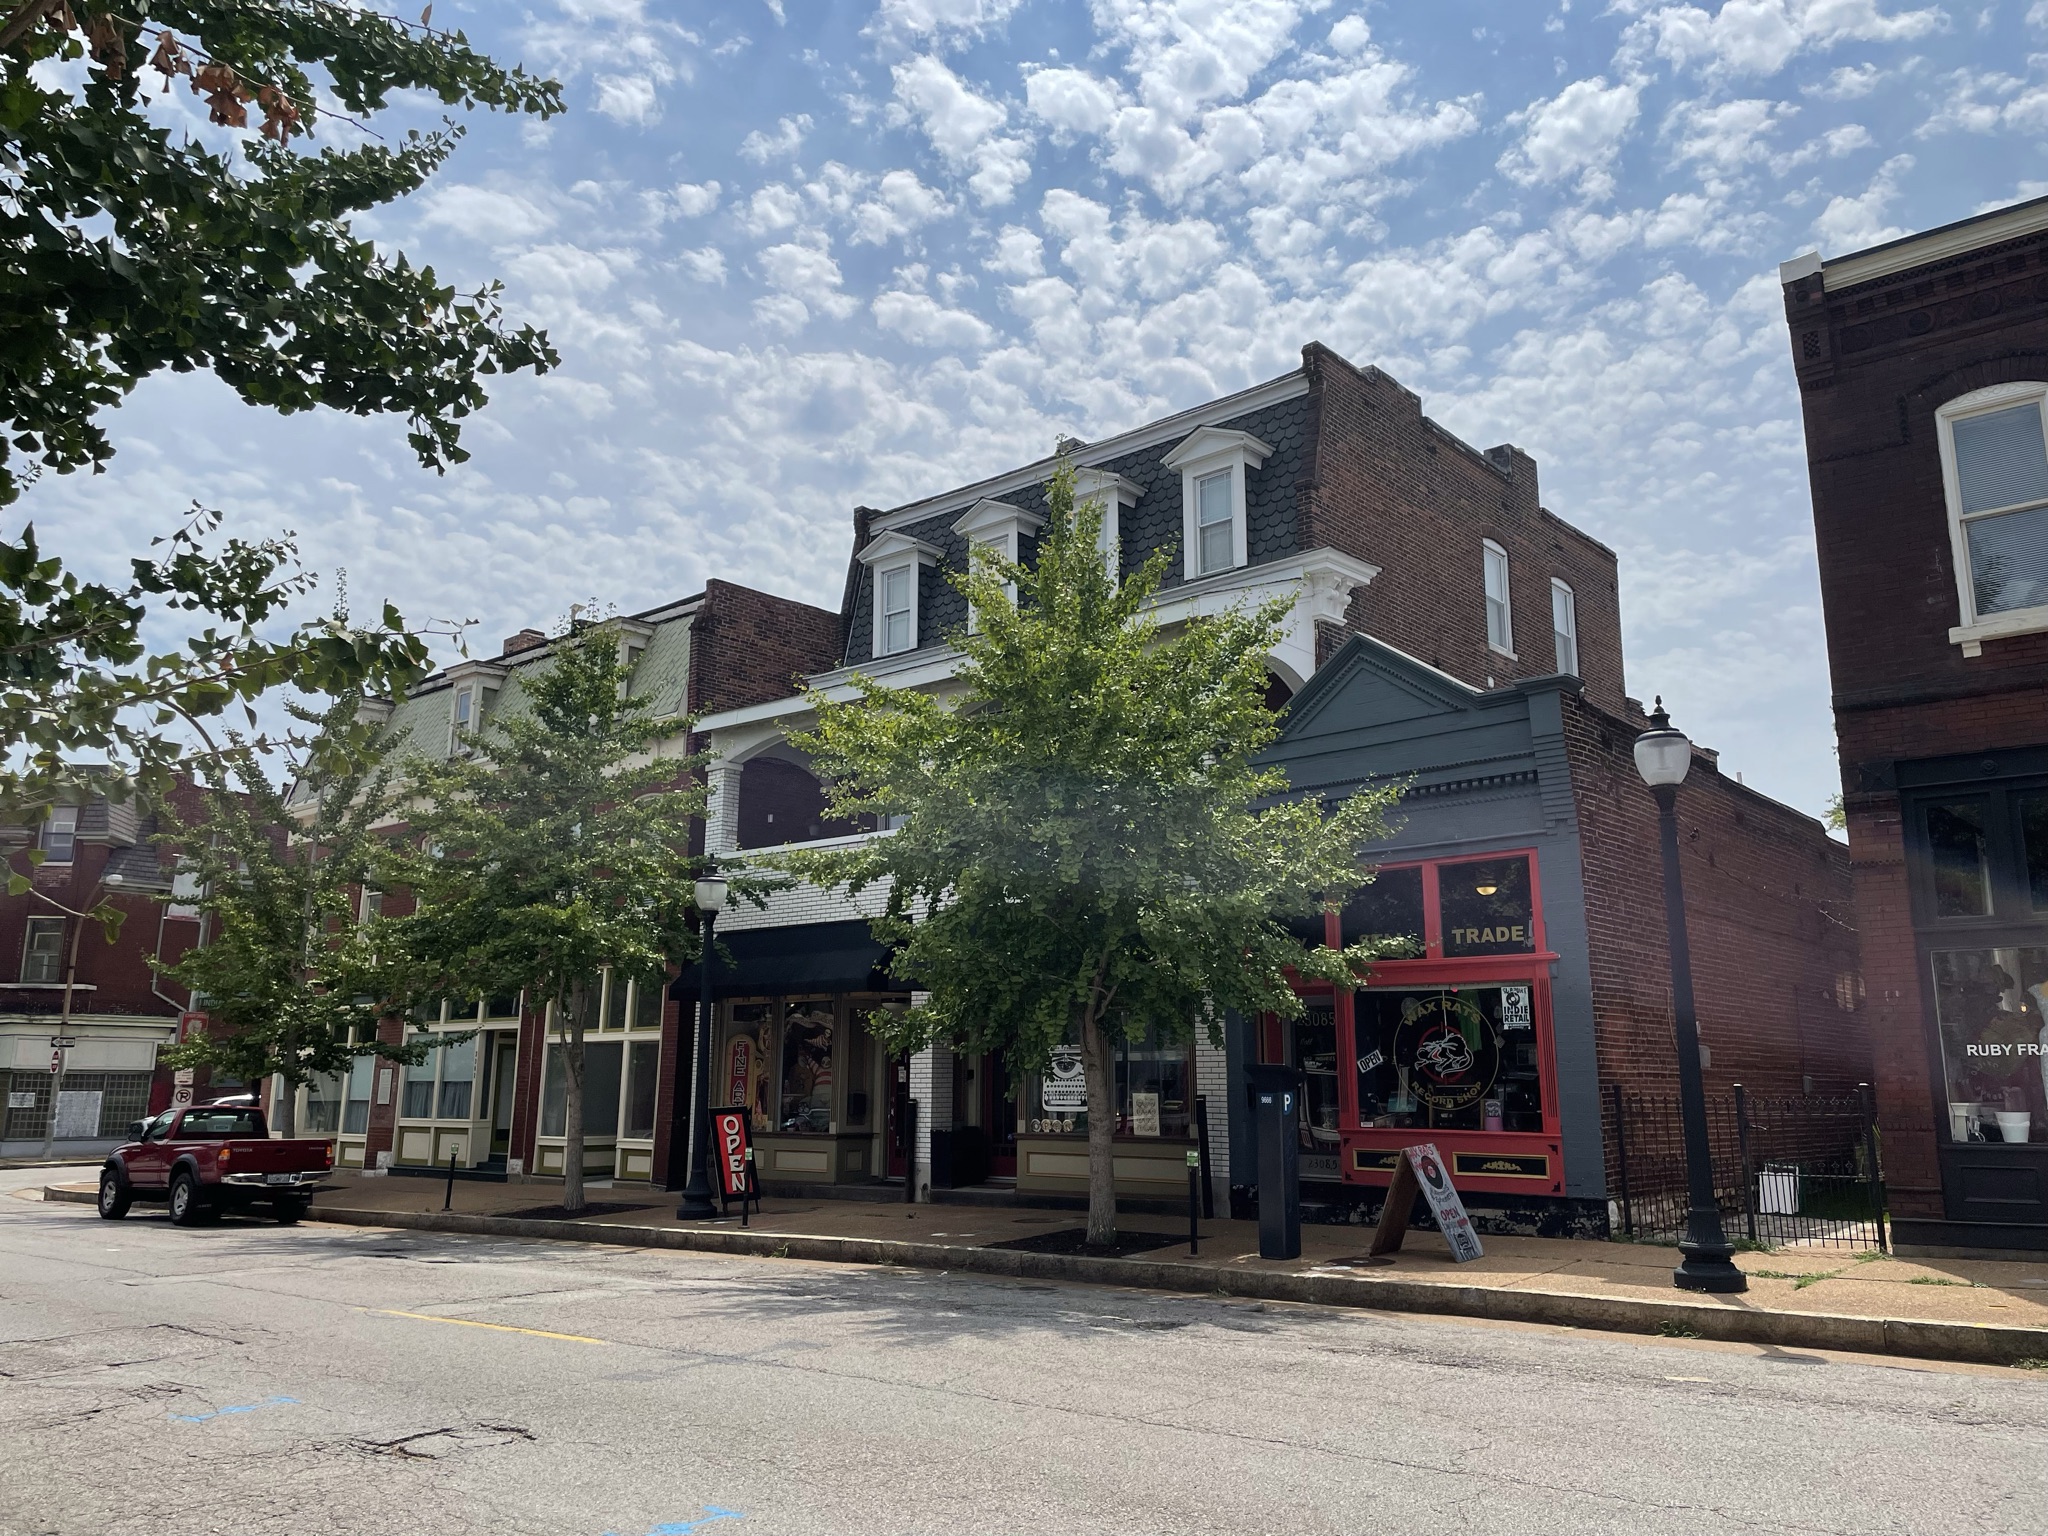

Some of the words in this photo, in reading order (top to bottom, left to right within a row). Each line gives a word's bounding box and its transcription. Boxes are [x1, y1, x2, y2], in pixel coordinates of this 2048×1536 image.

[1451, 926, 1525, 944] TRADE
[1404, 1001, 1438, 1026] WAX
[1441, 1000, 1481, 1025] RATS
[1503, 1005, 1529, 1015] INDIE
[1504, 1014, 1530, 1023] RETAIL
[733, 1040, 748, 1077] FINE
[1966, 1044, 2012, 1056] RUBY
[1360, 1051, 1381, 1072] OPEN
[1411, 1081, 1454, 1106] RECORD
[1457, 1081, 1482, 1104] SHOP
[723, 1115, 746, 1192] OPEN
[1441, 1206, 1460, 1221] OPEN
